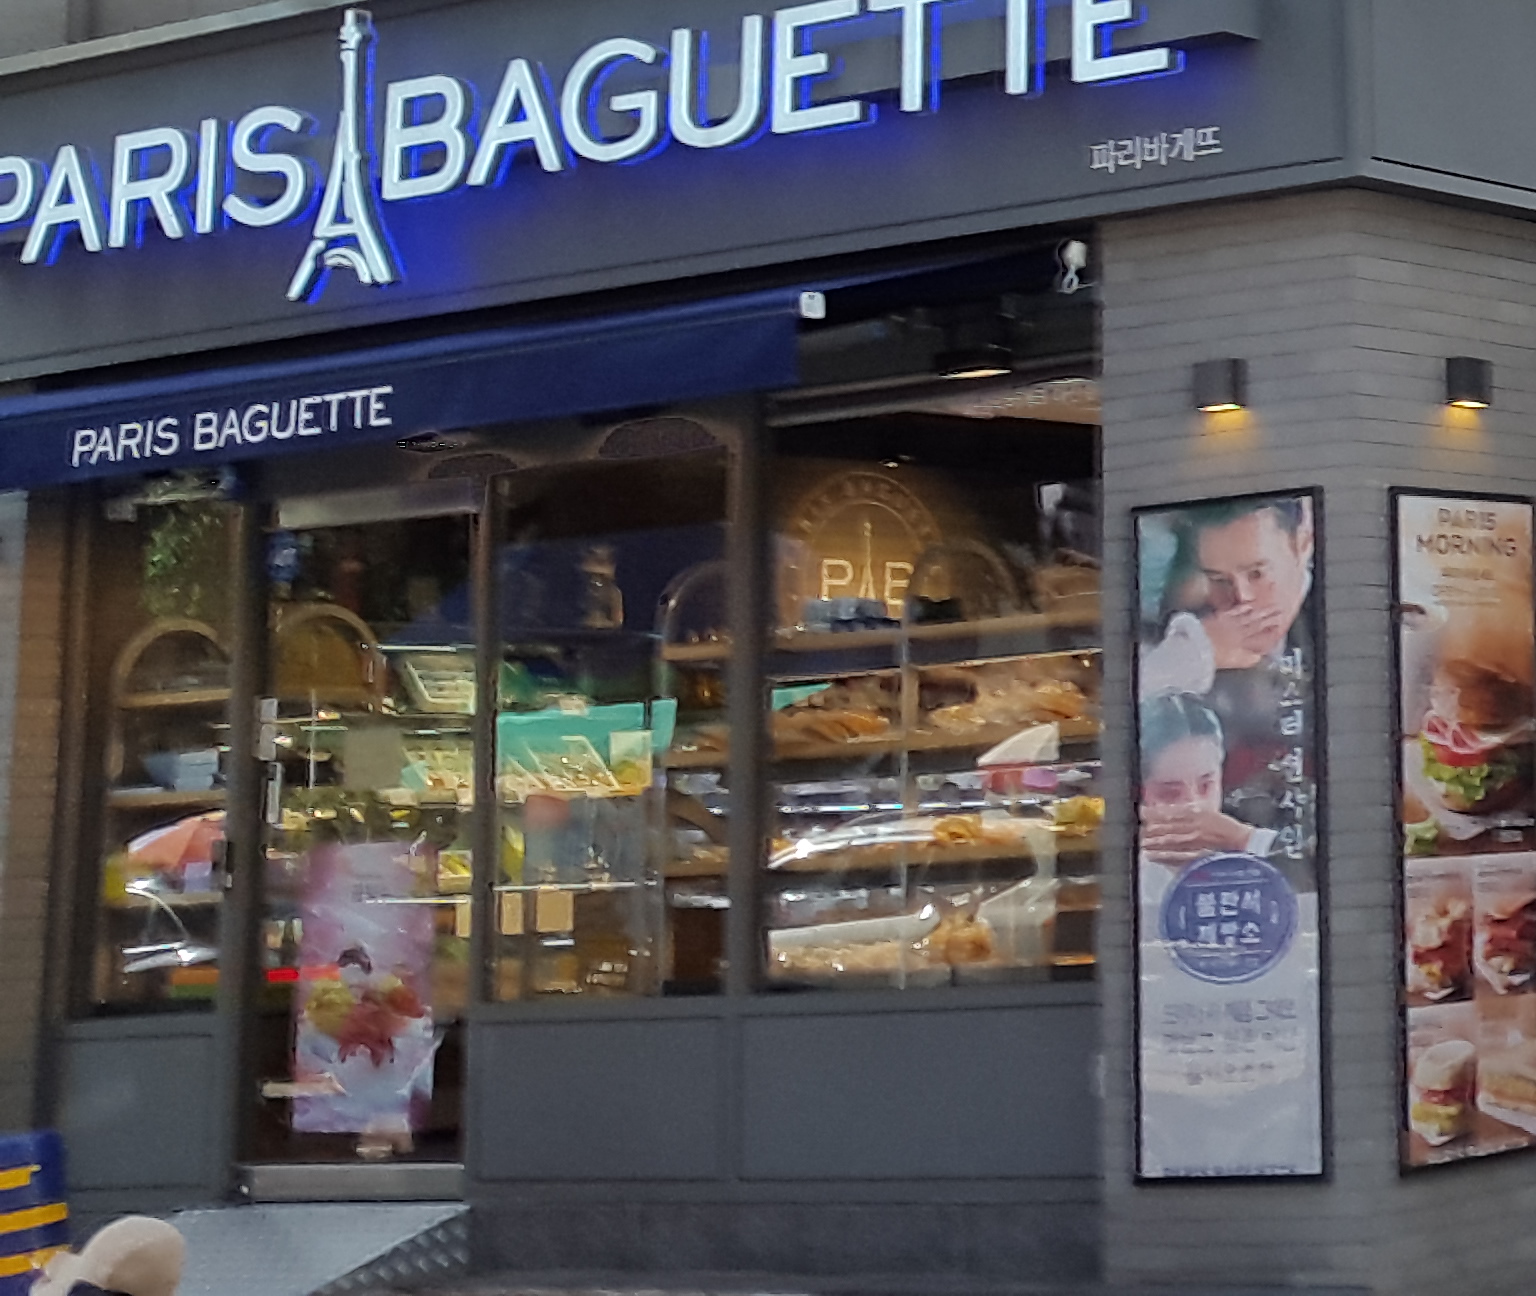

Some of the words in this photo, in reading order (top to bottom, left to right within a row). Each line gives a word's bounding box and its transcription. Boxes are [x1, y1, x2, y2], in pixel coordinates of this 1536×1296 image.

[1088, 124, 1225, 177] 파리바게뜨
[71, 419, 182, 468] PARIS
[192, 385, 395, 453] BAGUETTE
